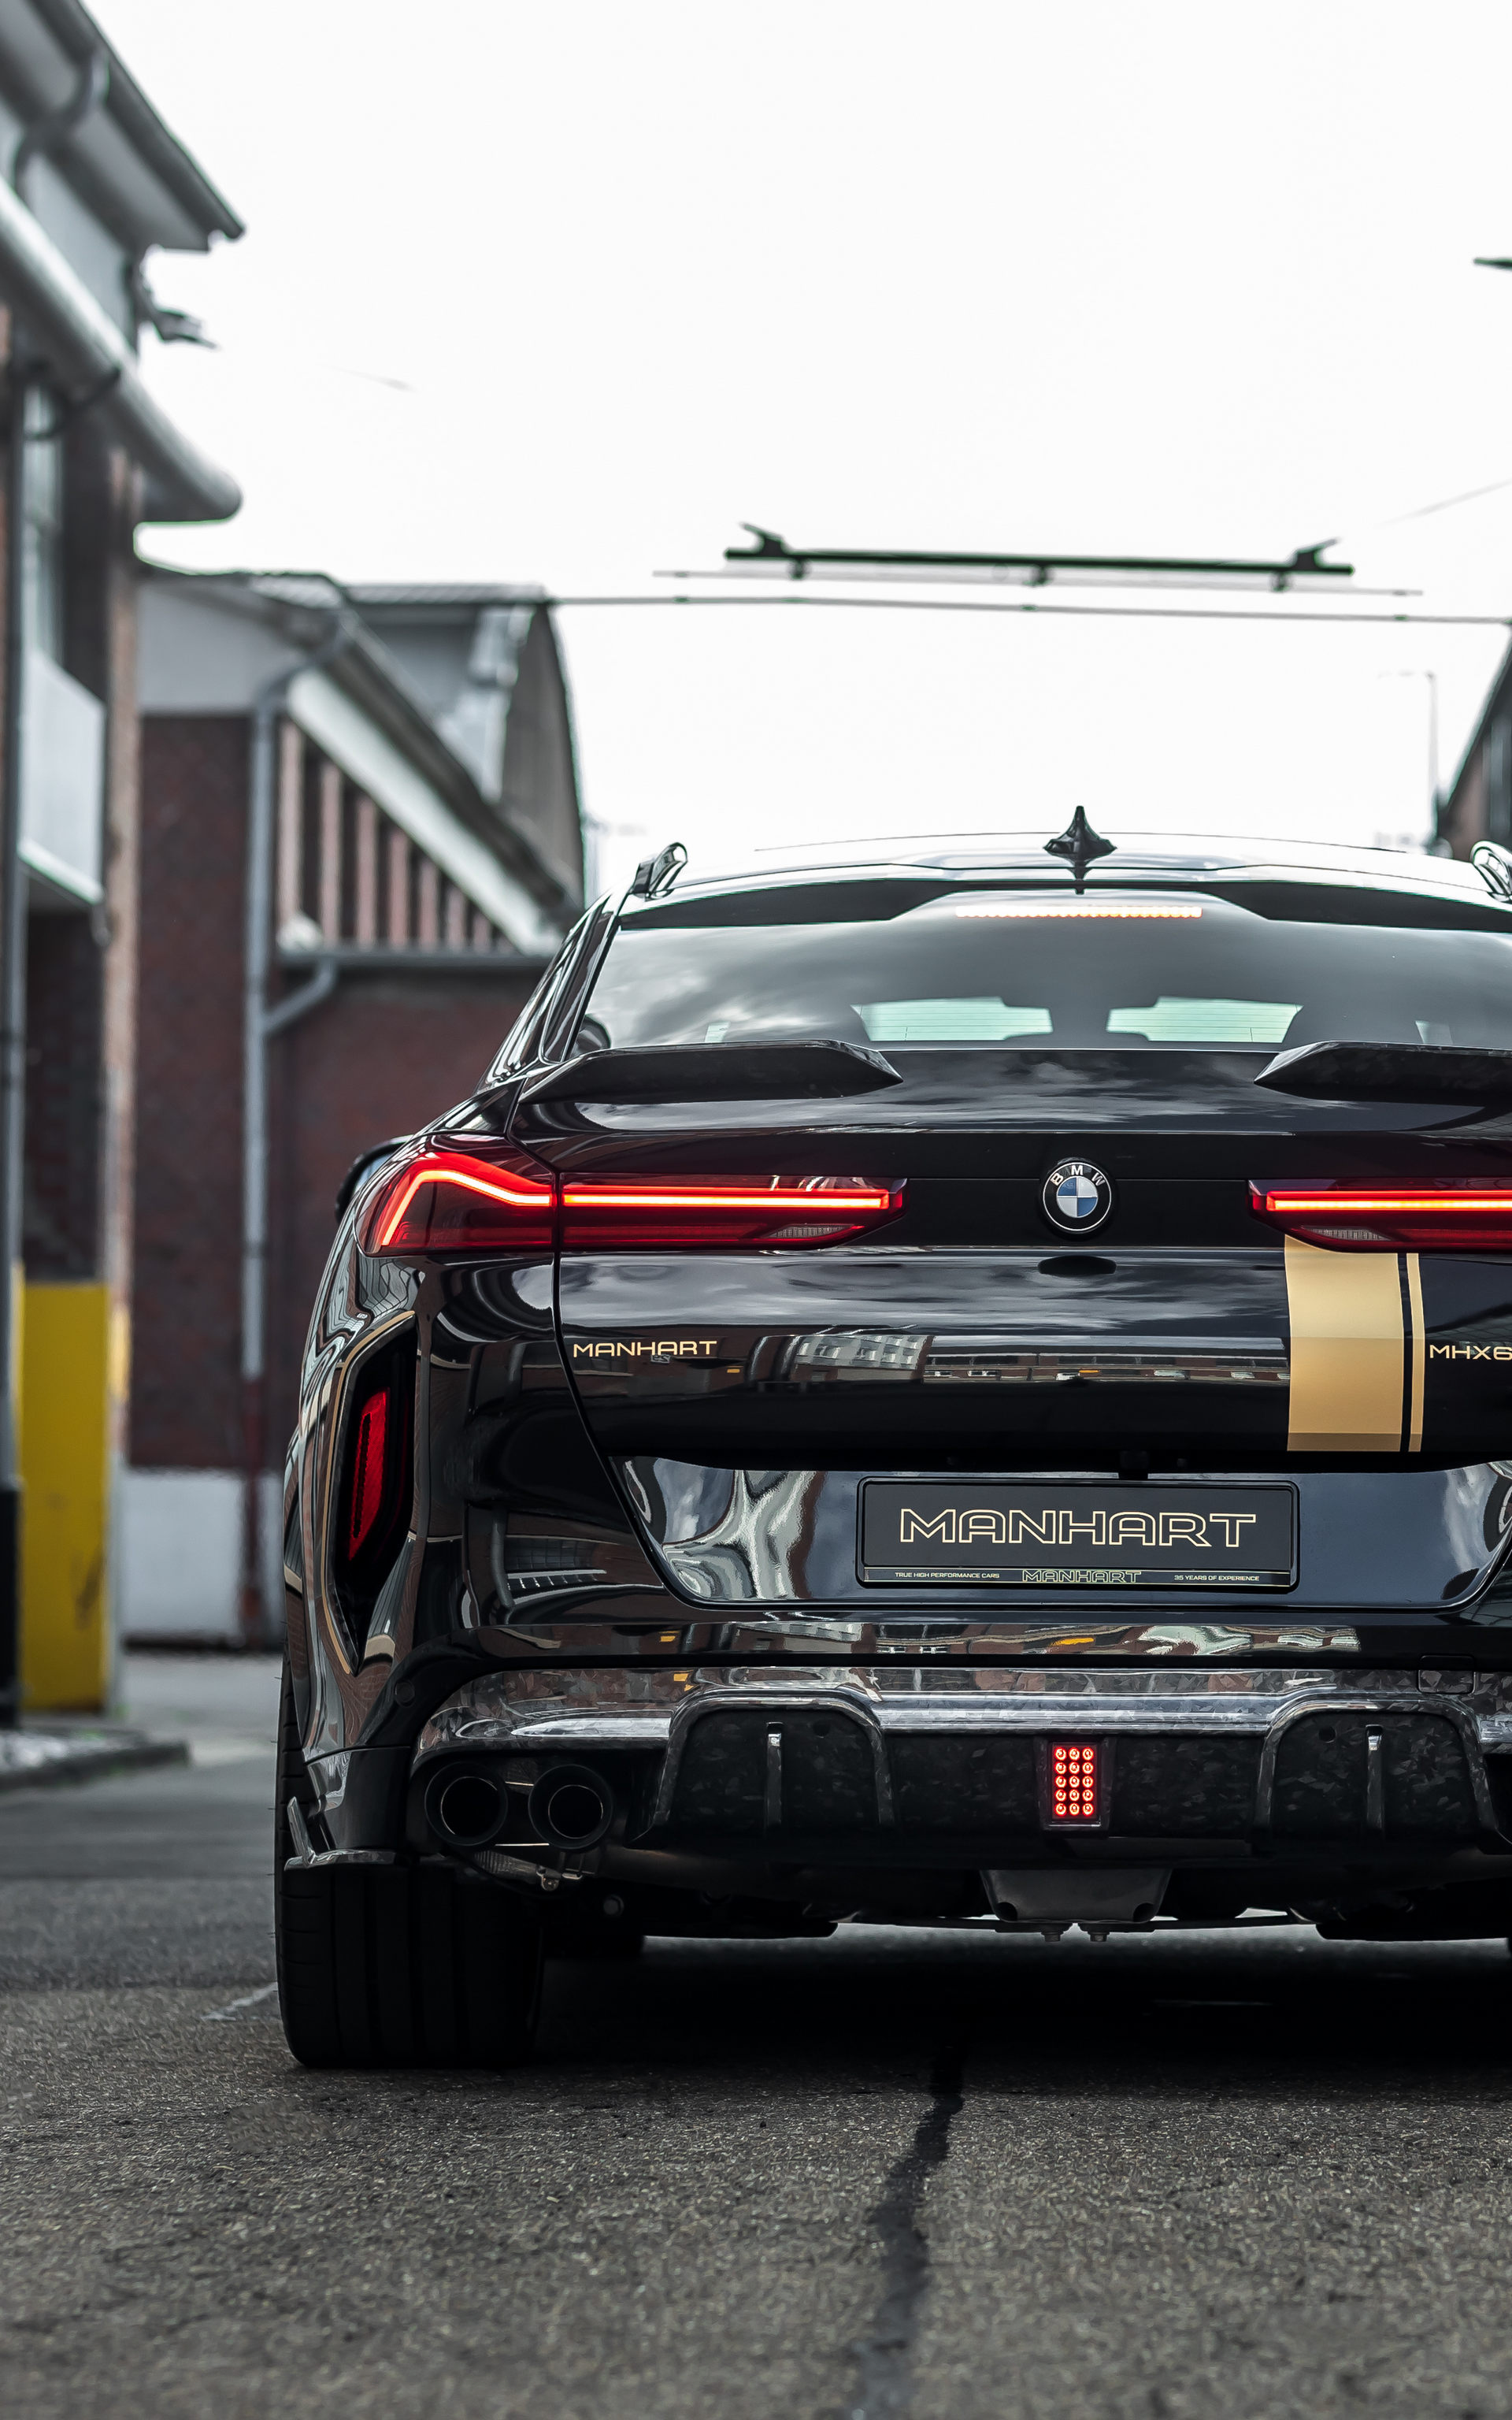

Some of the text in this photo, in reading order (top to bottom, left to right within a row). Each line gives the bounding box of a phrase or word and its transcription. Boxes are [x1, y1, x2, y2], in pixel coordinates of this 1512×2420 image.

[1050, 1164, 1106, 1186] BMW
[573, 1340, 717, 1358] MANHART
[1429, 1344, 1512, 1361] MHX6
[899, 1508, 1257, 1548] MANHART
[1022, 1569, 1142, 1583] MANHART
